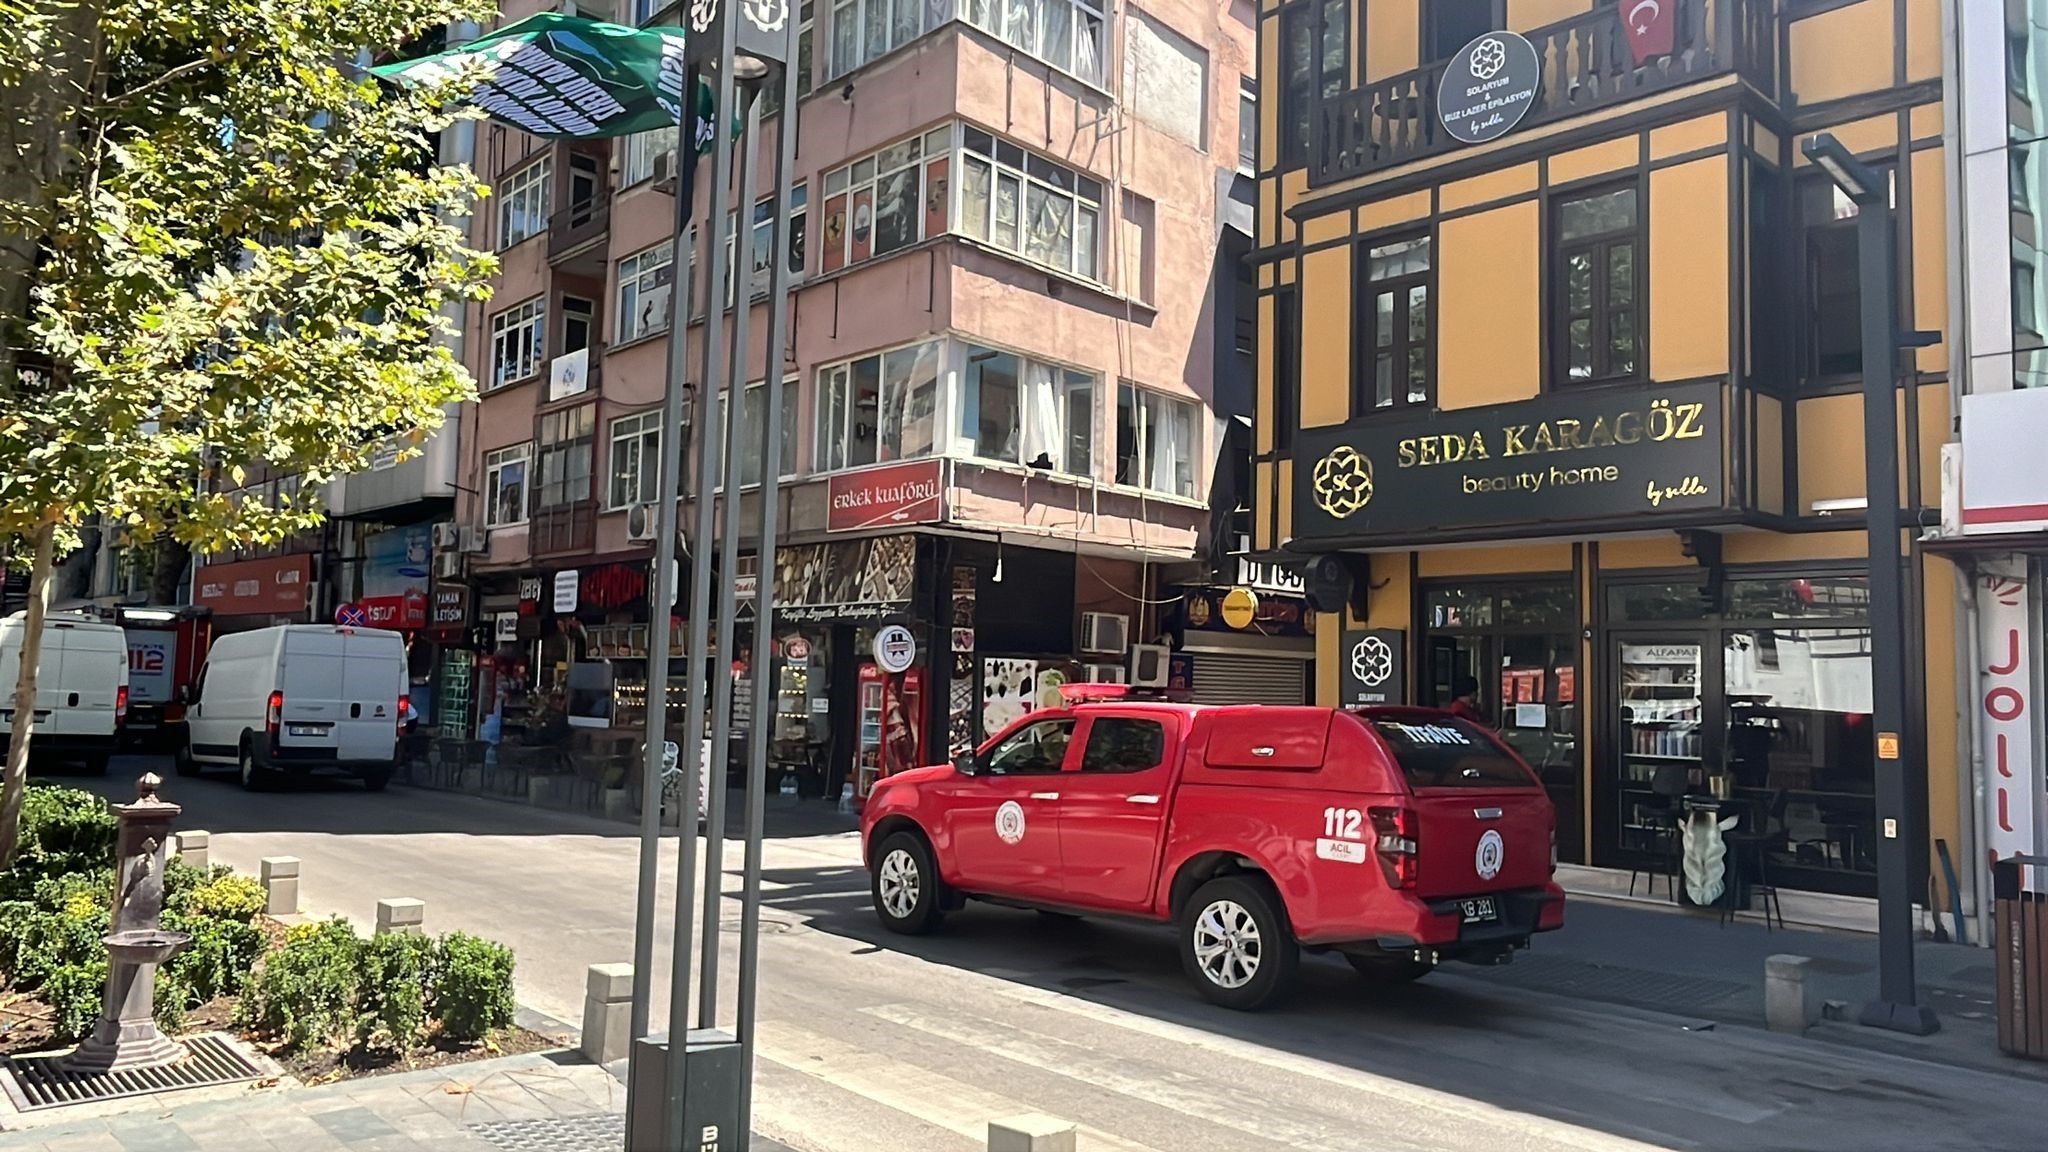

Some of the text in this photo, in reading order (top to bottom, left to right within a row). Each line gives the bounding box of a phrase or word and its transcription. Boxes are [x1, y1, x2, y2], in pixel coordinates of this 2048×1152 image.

[1461, 103, 1487, 117] LAZER
[1398, 399, 1704, 468] SEDA KARAGÖZ
[1463, 465, 1619, 494] beauty home
[1324, 807, 1362, 839] 112
